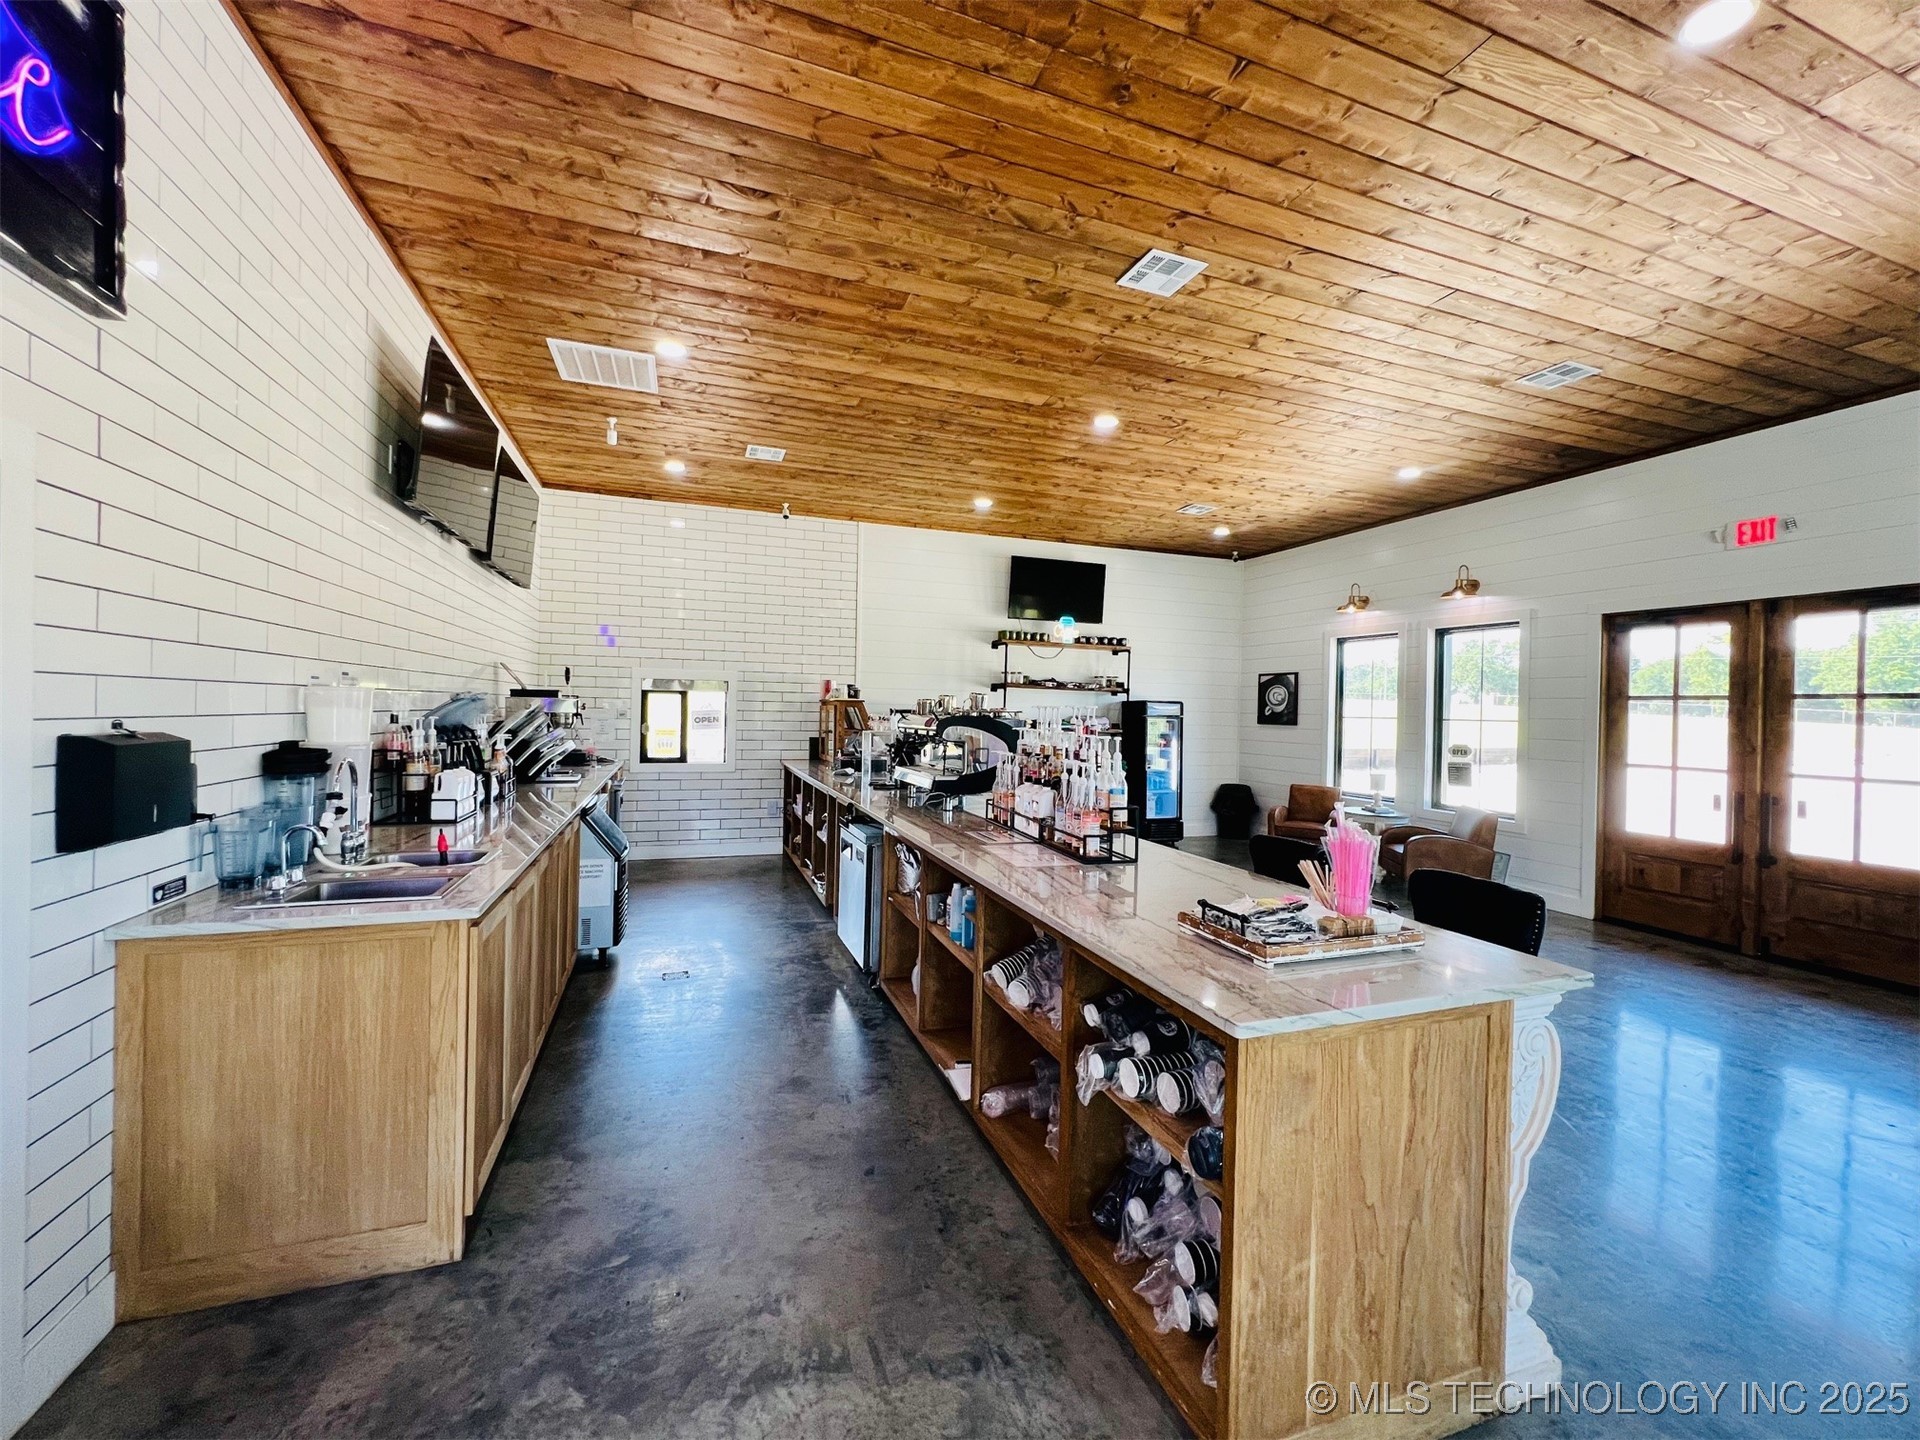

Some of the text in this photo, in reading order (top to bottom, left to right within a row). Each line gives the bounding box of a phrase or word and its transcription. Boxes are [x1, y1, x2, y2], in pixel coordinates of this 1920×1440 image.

[1737, 517, 1777, 546] EXIT
[694, 716, 719, 724] OPEN
[1452, 748, 1468, 756] OPEN
